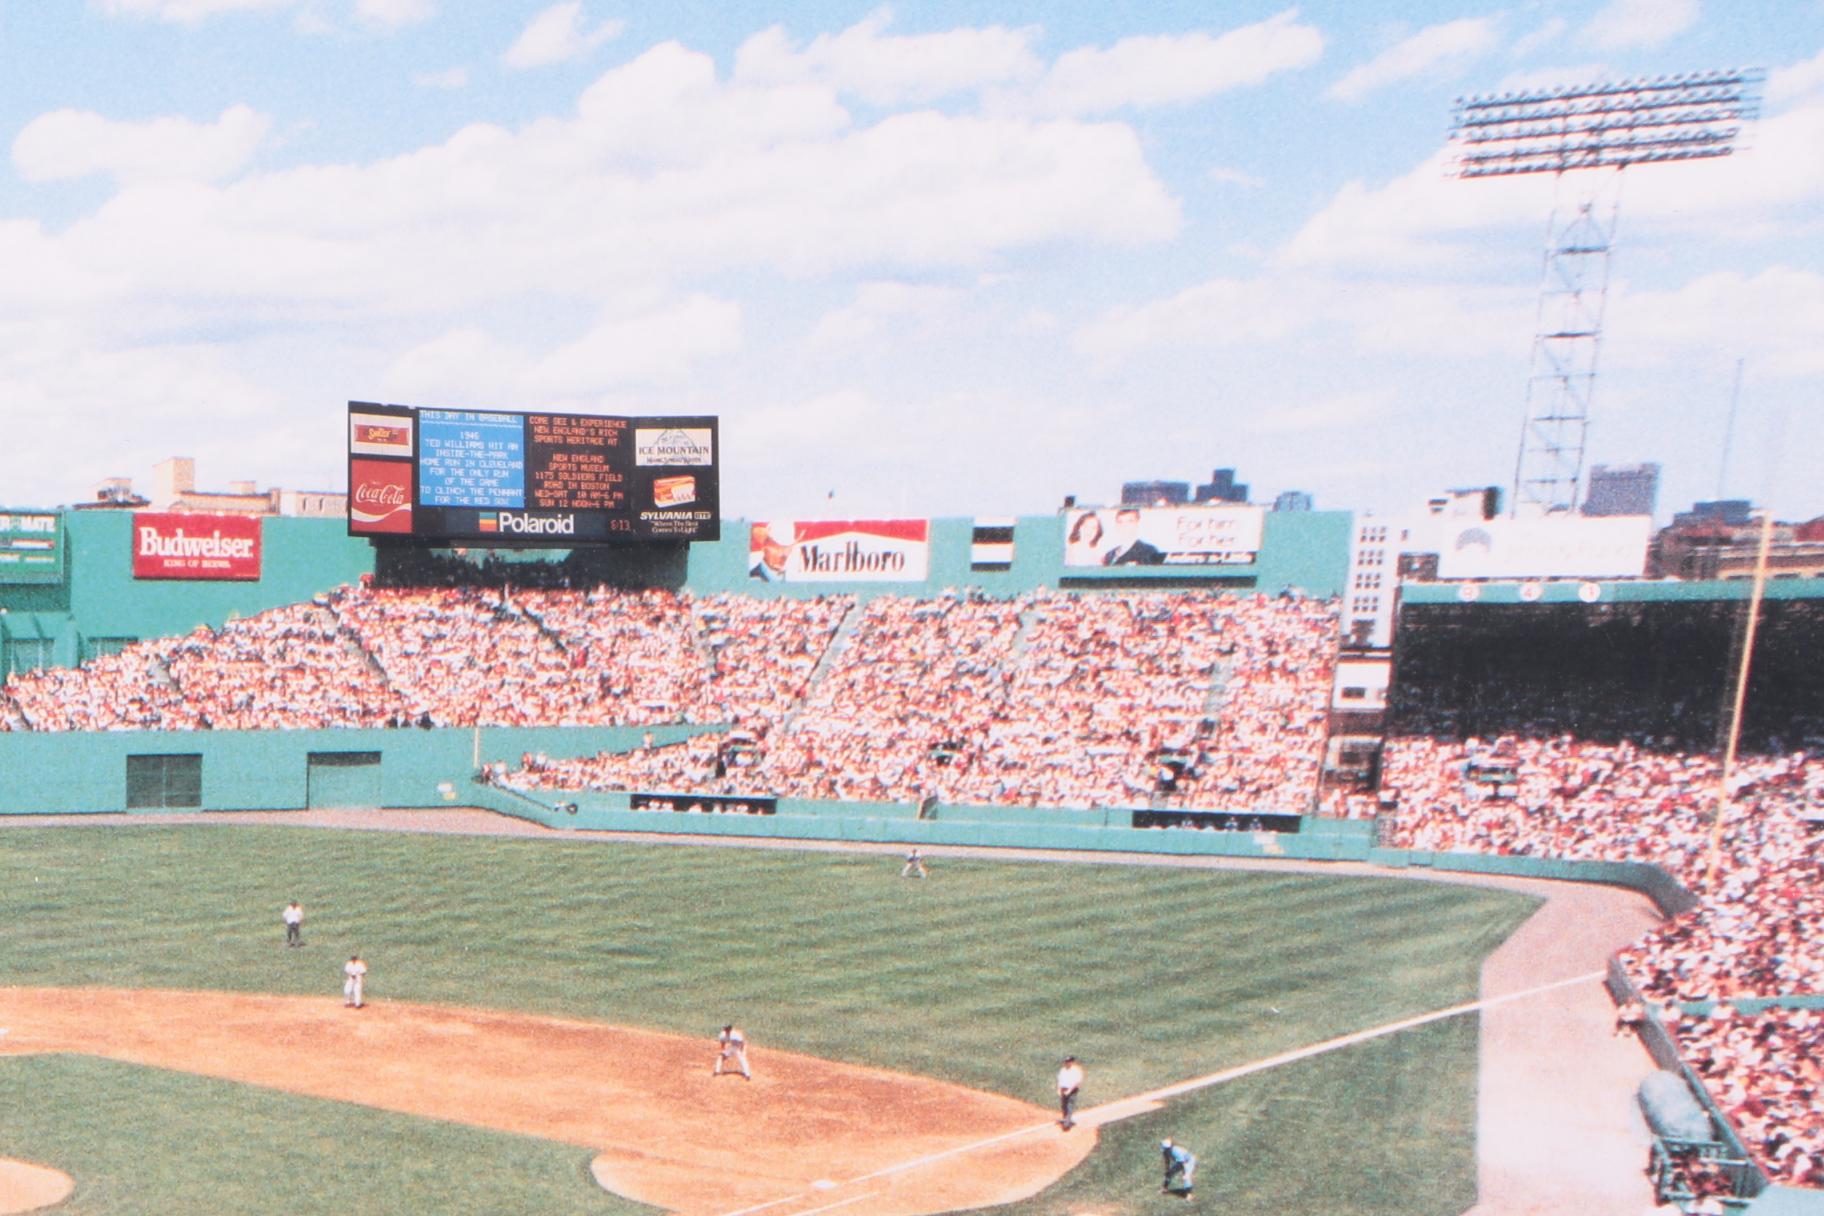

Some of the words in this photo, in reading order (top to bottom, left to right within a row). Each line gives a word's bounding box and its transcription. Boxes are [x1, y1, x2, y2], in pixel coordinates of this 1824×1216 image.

[419, 410, 441, 419] THIS
[444, 412, 460, 420] DAY
[465, 412, 476, 421] IN
[479, 413, 518, 423] BASEBALL
[529, 416, 548, 425] COME
[552, 417, 568, 425] SEE
[580, 418, 628, 428] EXPERIENCE
[534, 425, 549, 434] NEW
[552, 426, 596, 436] ENGLAND'S
[598, 428, 618, 437] RICH
[425, 438, 440, 447] TED
[444, 439, 485, 449] WILLIAMS
[488, 442, 504, 450] HIT
[534, 435, 563, 444] SPORTS
[566, 435, 605, 445] HERITAGE
[435, 449, 509, 460] INSIDE-THE-PARK
[638, 446, 653, 455] ICE
[657, 446, 709, 455] MOUNTAIN
[420, 458, 440, 466] HOME
[444, 459, 460, 467] RUN
[465, 459, 475, 468] IN
[479, 460, 523, 469] CLEVELAND
[552, 453, 568, 461] NEW
[571, 454, 605, 463] ENGLAND
[430, 467, 445, 476] FOR
[450, 467, 465, 476] THE
[469, 468, 489, 477] ONLY
[493, 469, 509, 478] RUN
[548, 462, 577, 471] SPORTS
[580, 464, 610, 472] MUSEUM
[444, 477, 455, 485] OF
[460, 477, 475, 486] THE
[479, 478, 500, 487] GAME
[558, 471, 596, 481] SOLDIERS
[599, 473, 623, 482] FIELD
[543, 480, 564, 489] ROAD
[567, 481, 577, 490] IN
[580, 482, 610, 490] BOSTON
[420, 486, 431, 494] TO
[434, 486, 465, 495] CLINCH
[469, 487, 485, 495] THE
[488, 487, 523, 497] PENNANT
[613, 491, 624, 500] PM
[435, 496, 451, 504] FOR
[455, 496, 470, 505] THE
[474, 497, 489, 505] RED
[539, 498, 555, 507] SUN
[603, 500, 615, 508] PM
[639, 511, 693, 520] SYLVANIA
[498, 511, 574, 534] Polaroid
[139, 526, 254, 558] Budweiser
[800, 540, 906, 573] Marlboro
[163, 559, 186, 568] KING
[187, 559, 199, 568] OF
